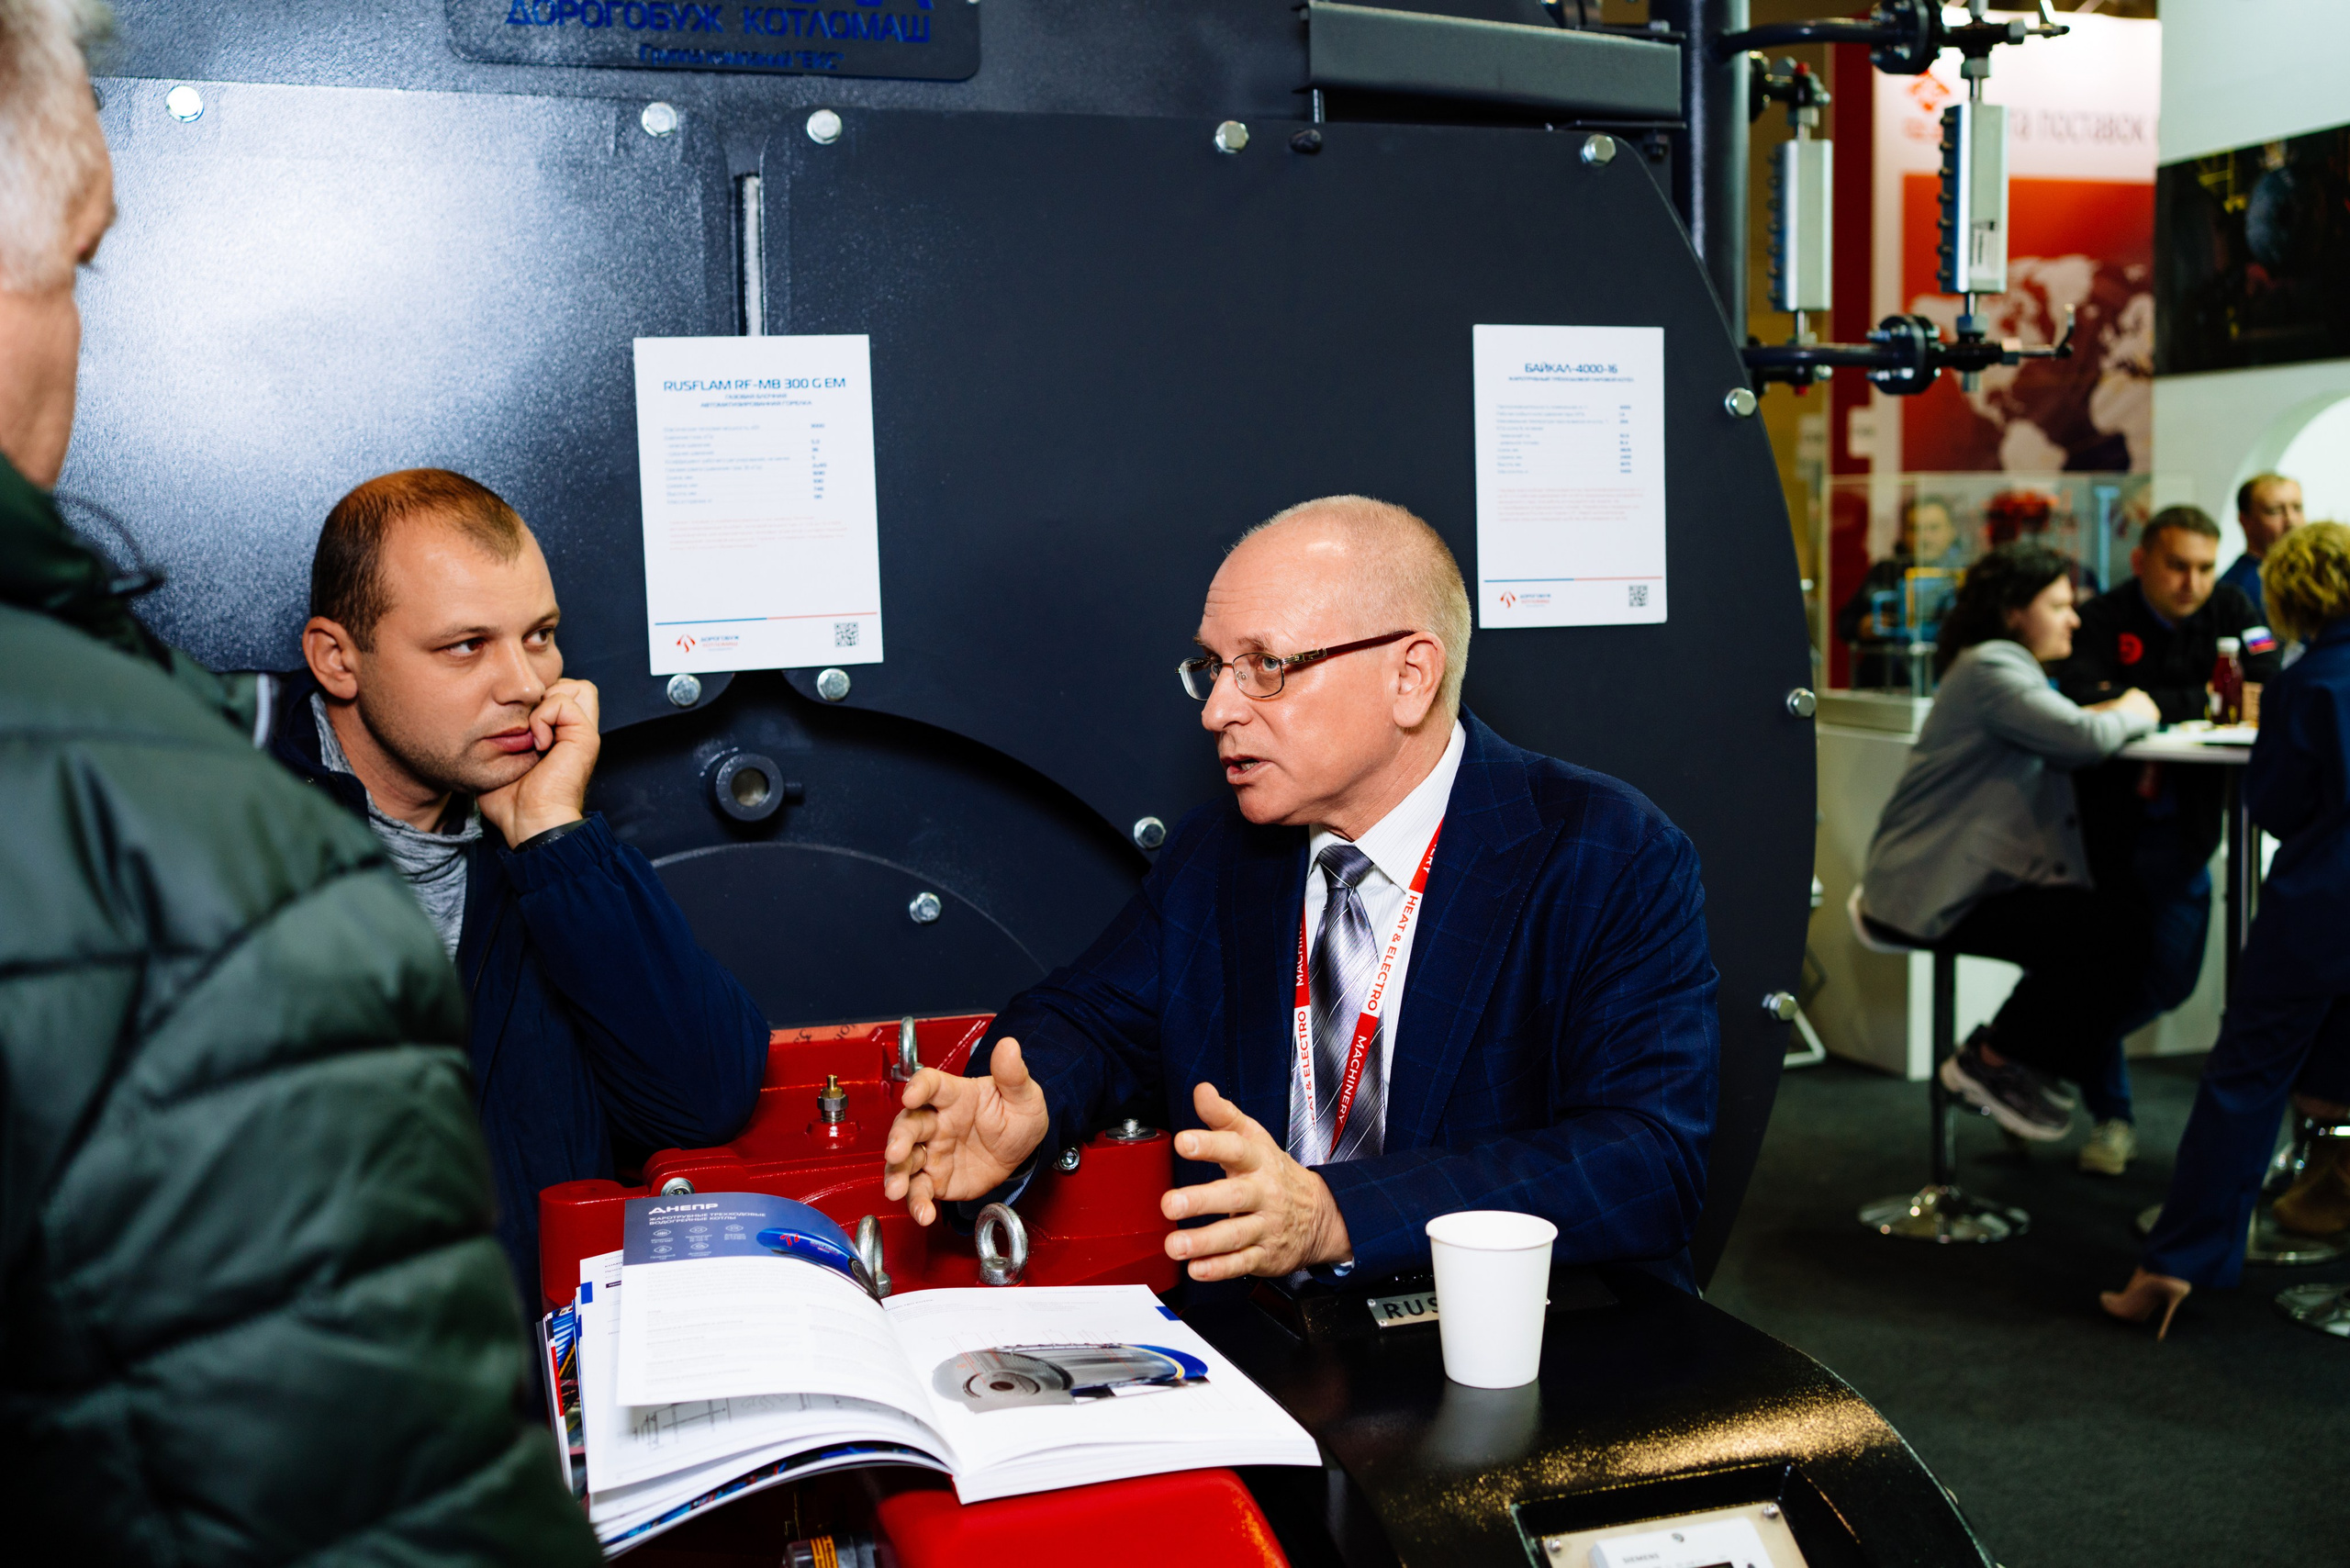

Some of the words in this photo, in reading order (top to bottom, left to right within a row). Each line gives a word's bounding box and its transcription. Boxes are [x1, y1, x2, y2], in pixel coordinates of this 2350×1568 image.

[506, 0, 723, 33] ДОРОГОБУЖ
[744, 6, 930, 43] КОТЛОМАШ
[1525, 362, 1617, 374] БАЙКАЛ-4000-16
[664, 379, 732, 391] RUSFLAM
[734, 379, 781, 390] RF-MB
[784, 378, 809, 389] 300
[811, 377, 822, 389] G
[824, 377, 845, 388] EM
[1395, 894, 1419, 934] HEAT
[1393, 934, 1403, 943] &
[1368, 945, 1398, 1012] ELECTRO
[1297, 1010, 1312, 1077] ELECTRO
[1304, 1081, 1313, 1091] &
[1337, 1035, 1368, 1125] MACHINERY
[648, 1203, 719, 1215] ДНЕПР
[649, 1213, 708, 1222] ЖАРОТРУБНЫЕ
[649, 1217, 708, 1226] ВОДОГРЕЙНЫЕ
[1382, 1296, 1438, 1319] RUS
[1623, 1552, 1660, 1564] SIEMENS
